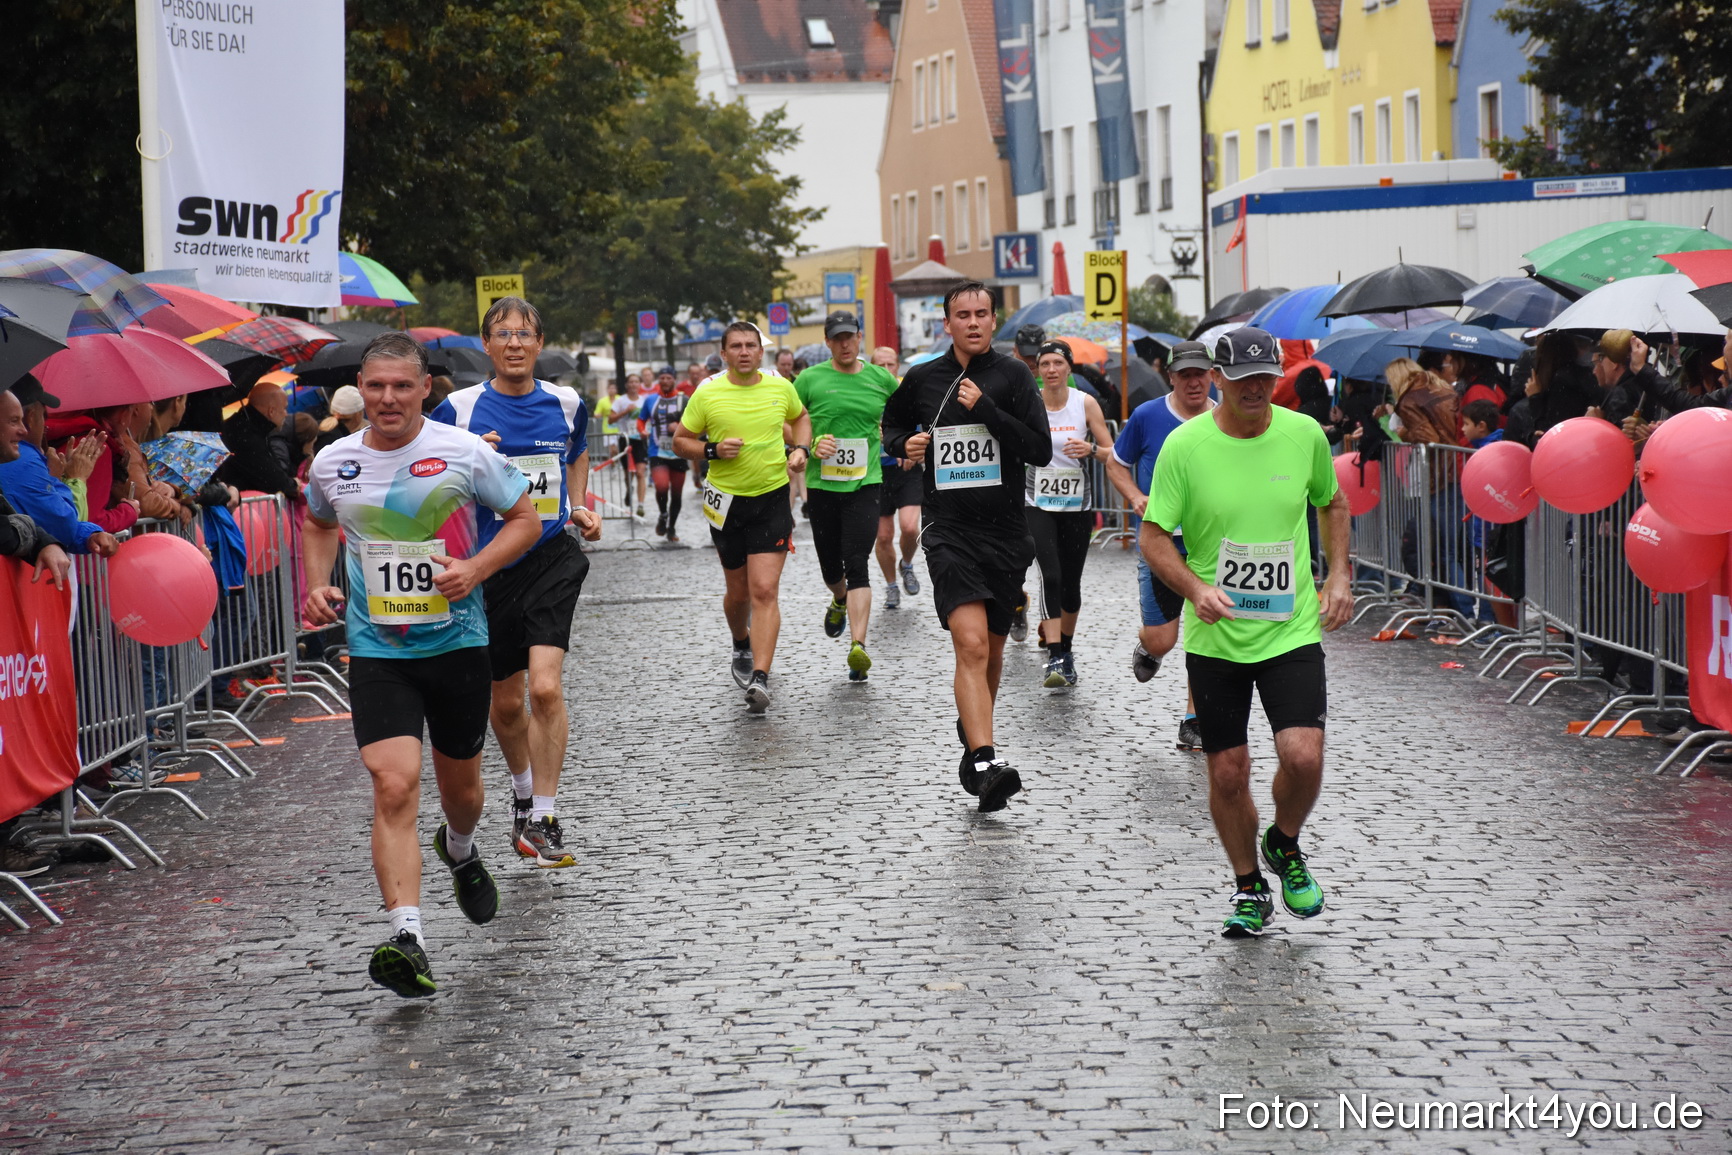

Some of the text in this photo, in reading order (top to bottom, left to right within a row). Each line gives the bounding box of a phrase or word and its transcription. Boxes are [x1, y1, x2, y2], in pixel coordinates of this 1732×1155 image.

[192, 30, 213, 51] SIE
[218, 33, 245, 53] DA!
[1000, 23, 1032, 102] K&L
[1262, 79, 1291, 113] HOTEL
[176, 196, 278, 242] swn
[174, 241, 310, 264] stadtwerke neumarkt
[1089, 253, 1123, 267] Block
[216, 264, 332, 283] wir bieten lebensqualität
[482, 278, 518, 292] Block
[1096, 272, 1116, 306] D
[836, 449, 855, 465] 33
[940, 439, 995, 465] 2884
[414, 462, 443, 473] Hervis
[519, 457, 554, 467] BOCK
[836, 468, 853, 476] Peter
[949, 470, 985, 480] Andreas
[337, 483, 361, 491] PARTL
[337, 488, 361, 496] Neumarkt
[1040, 478, 1080, 495] 2497
[398, 544, 437, 555] BOCK
[1254, 545, 1289, 556] BOCK
[378, 562, 433, 592] 169
[1222, 560, 1289, 591] 2230
[383, 600, 429, 613] Thomas
[1239, 598, 1270, 609] Josef
